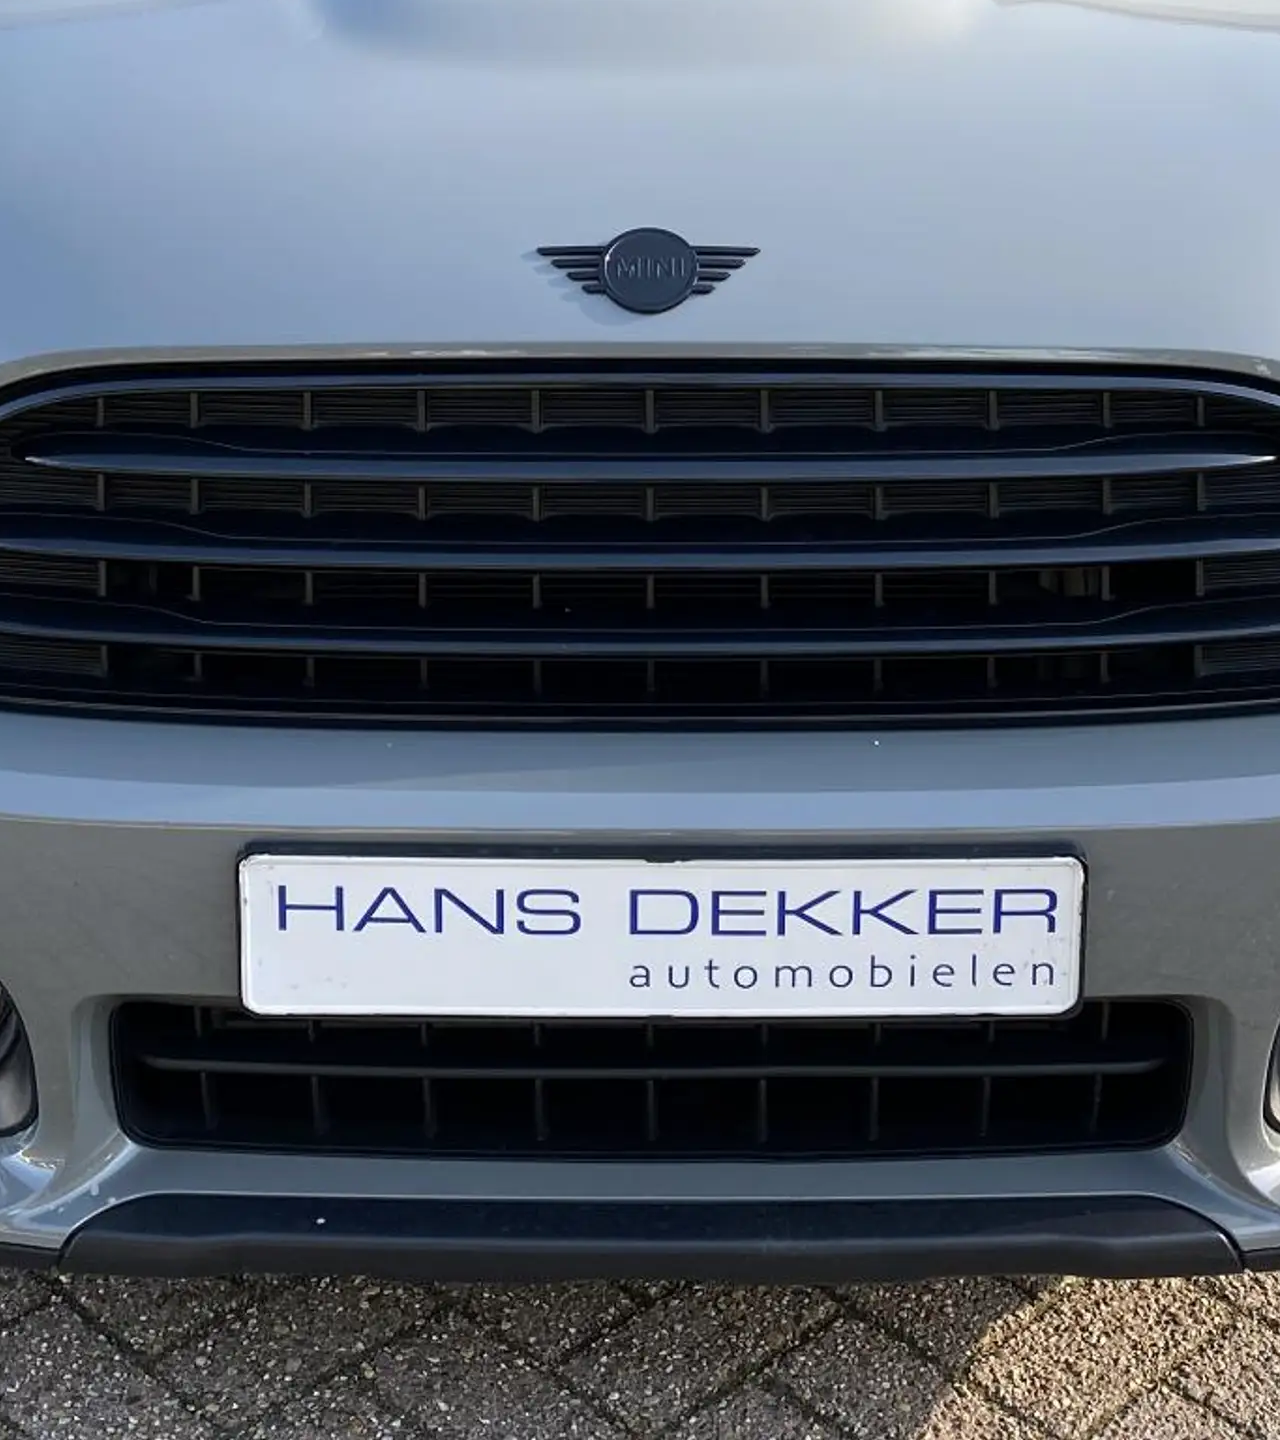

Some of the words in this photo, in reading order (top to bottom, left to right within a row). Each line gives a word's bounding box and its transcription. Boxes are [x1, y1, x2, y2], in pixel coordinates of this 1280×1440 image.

[614, 255, 687, 279] MINI
[277, 885, 582, 936] HANS
[628, 888, 1058, 937] DEKKER
[628, 954, 1055, 989] automobielen
